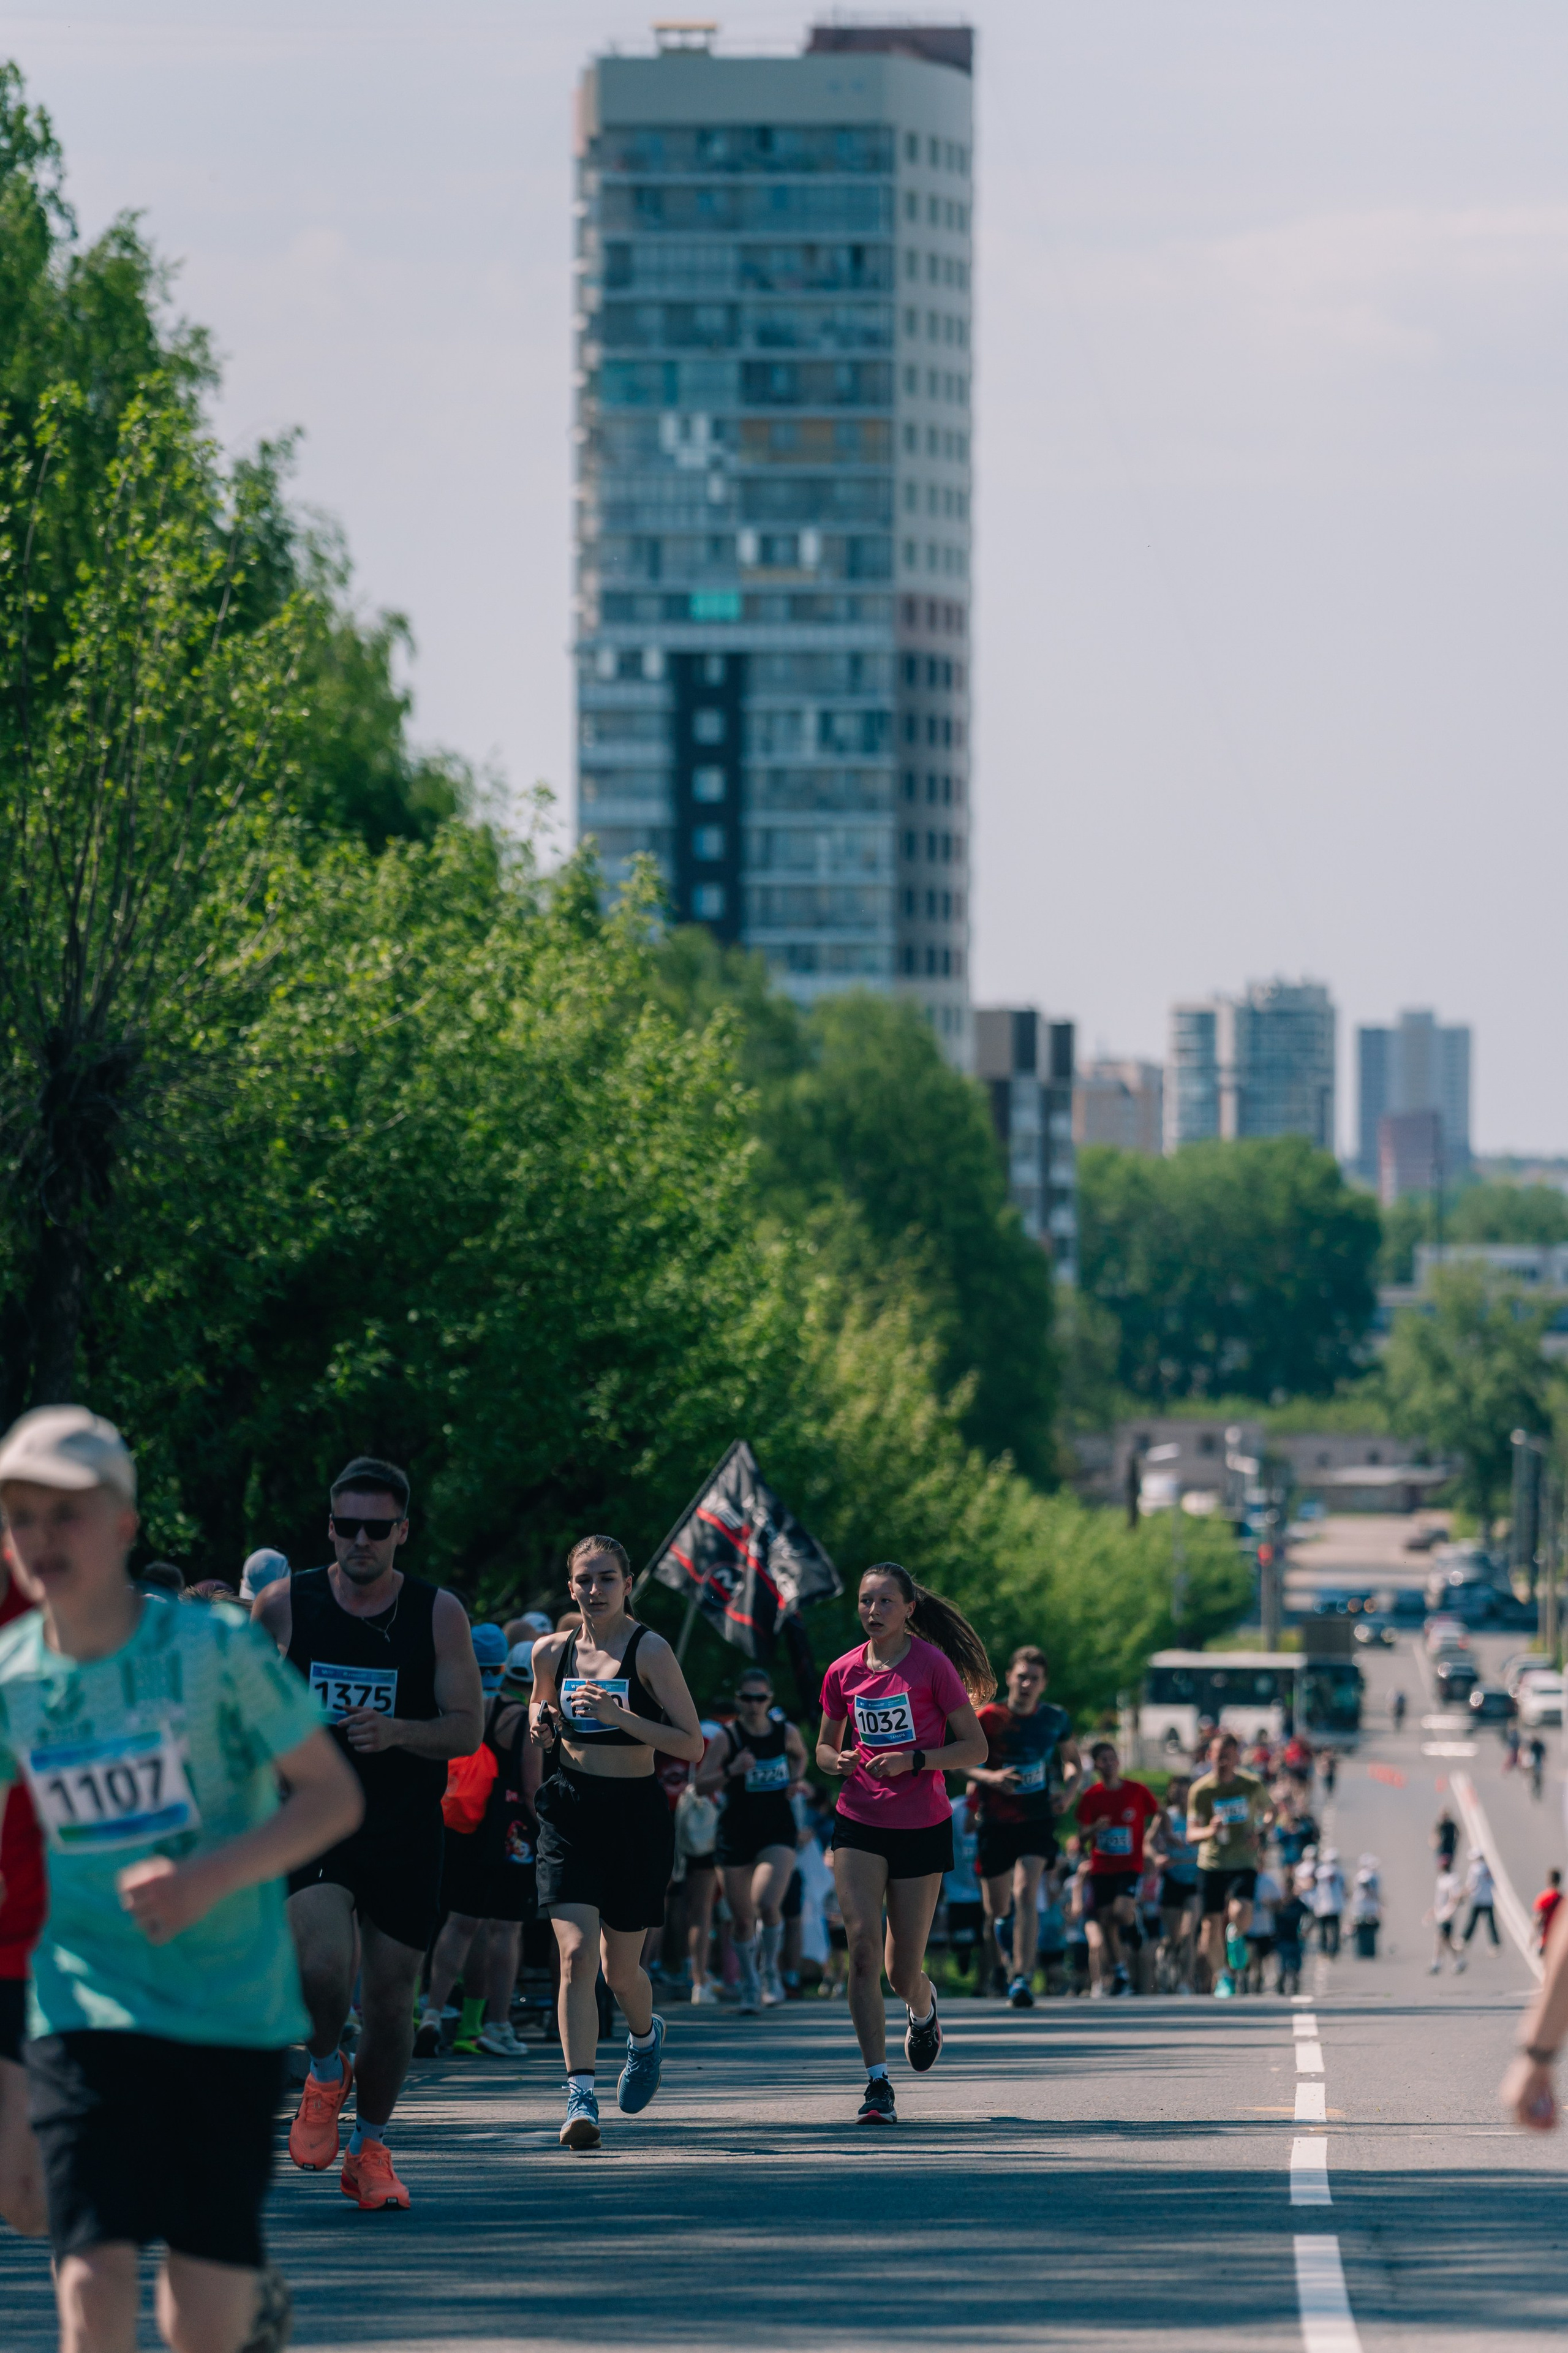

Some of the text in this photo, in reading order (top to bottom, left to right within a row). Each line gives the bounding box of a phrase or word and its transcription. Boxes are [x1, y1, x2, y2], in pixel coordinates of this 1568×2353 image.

[314, 1680, 391, 1713] 1375
[858, 1708, 908, 1733] 1032
[49, 1758, 162, 1818] 1107
